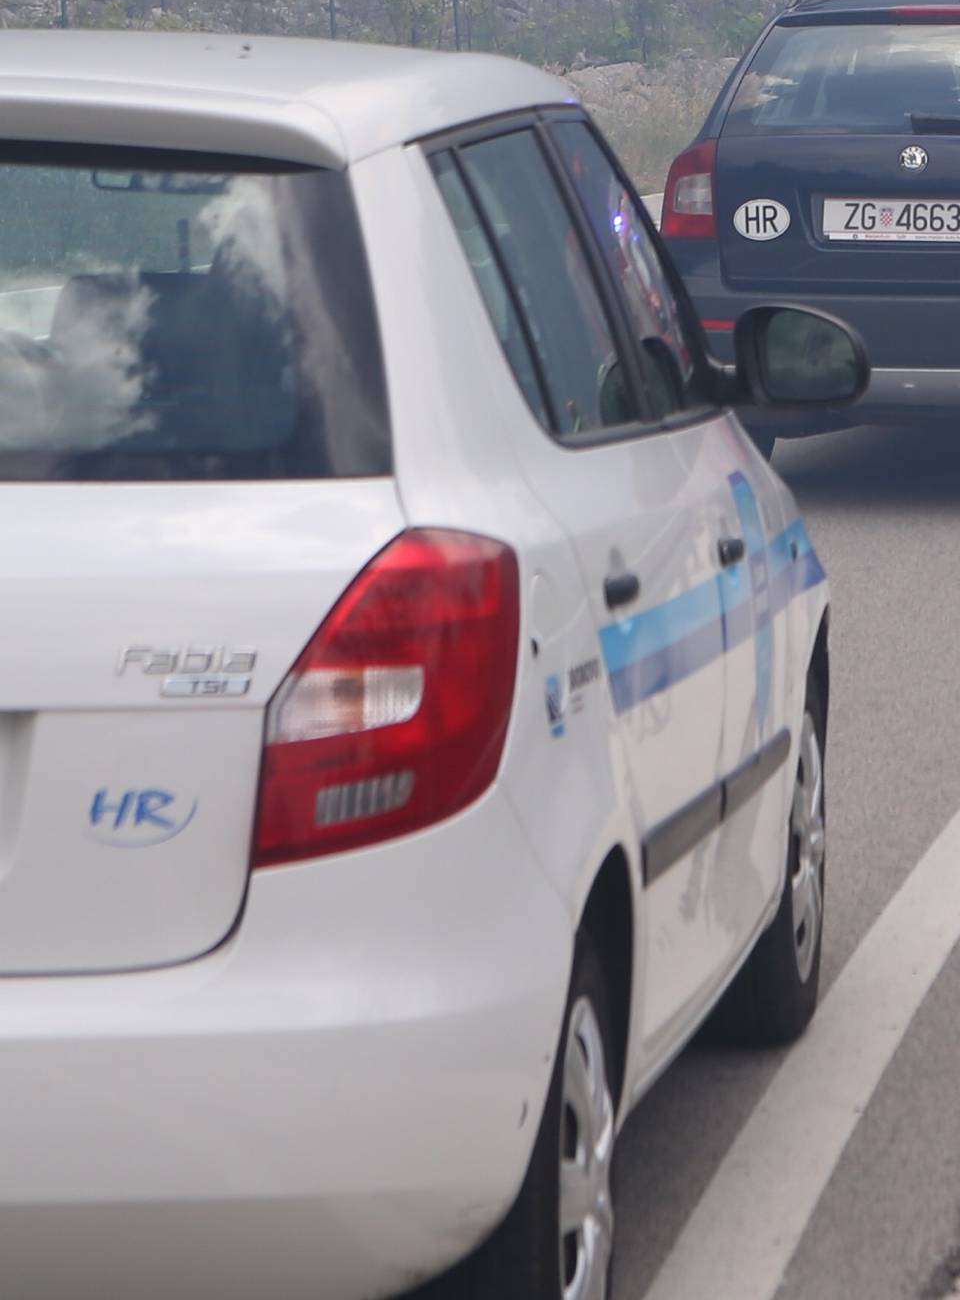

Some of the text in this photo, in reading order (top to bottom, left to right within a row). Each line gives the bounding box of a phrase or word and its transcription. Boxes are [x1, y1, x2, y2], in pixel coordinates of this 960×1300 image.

[745, 205, 778, 233] HR
[844, 203, 877, 230] ZG
[115, 646, 257, 676] Fabia
[189, 679, 229, 695] TSI
[89, 787, 176, 831] HR
